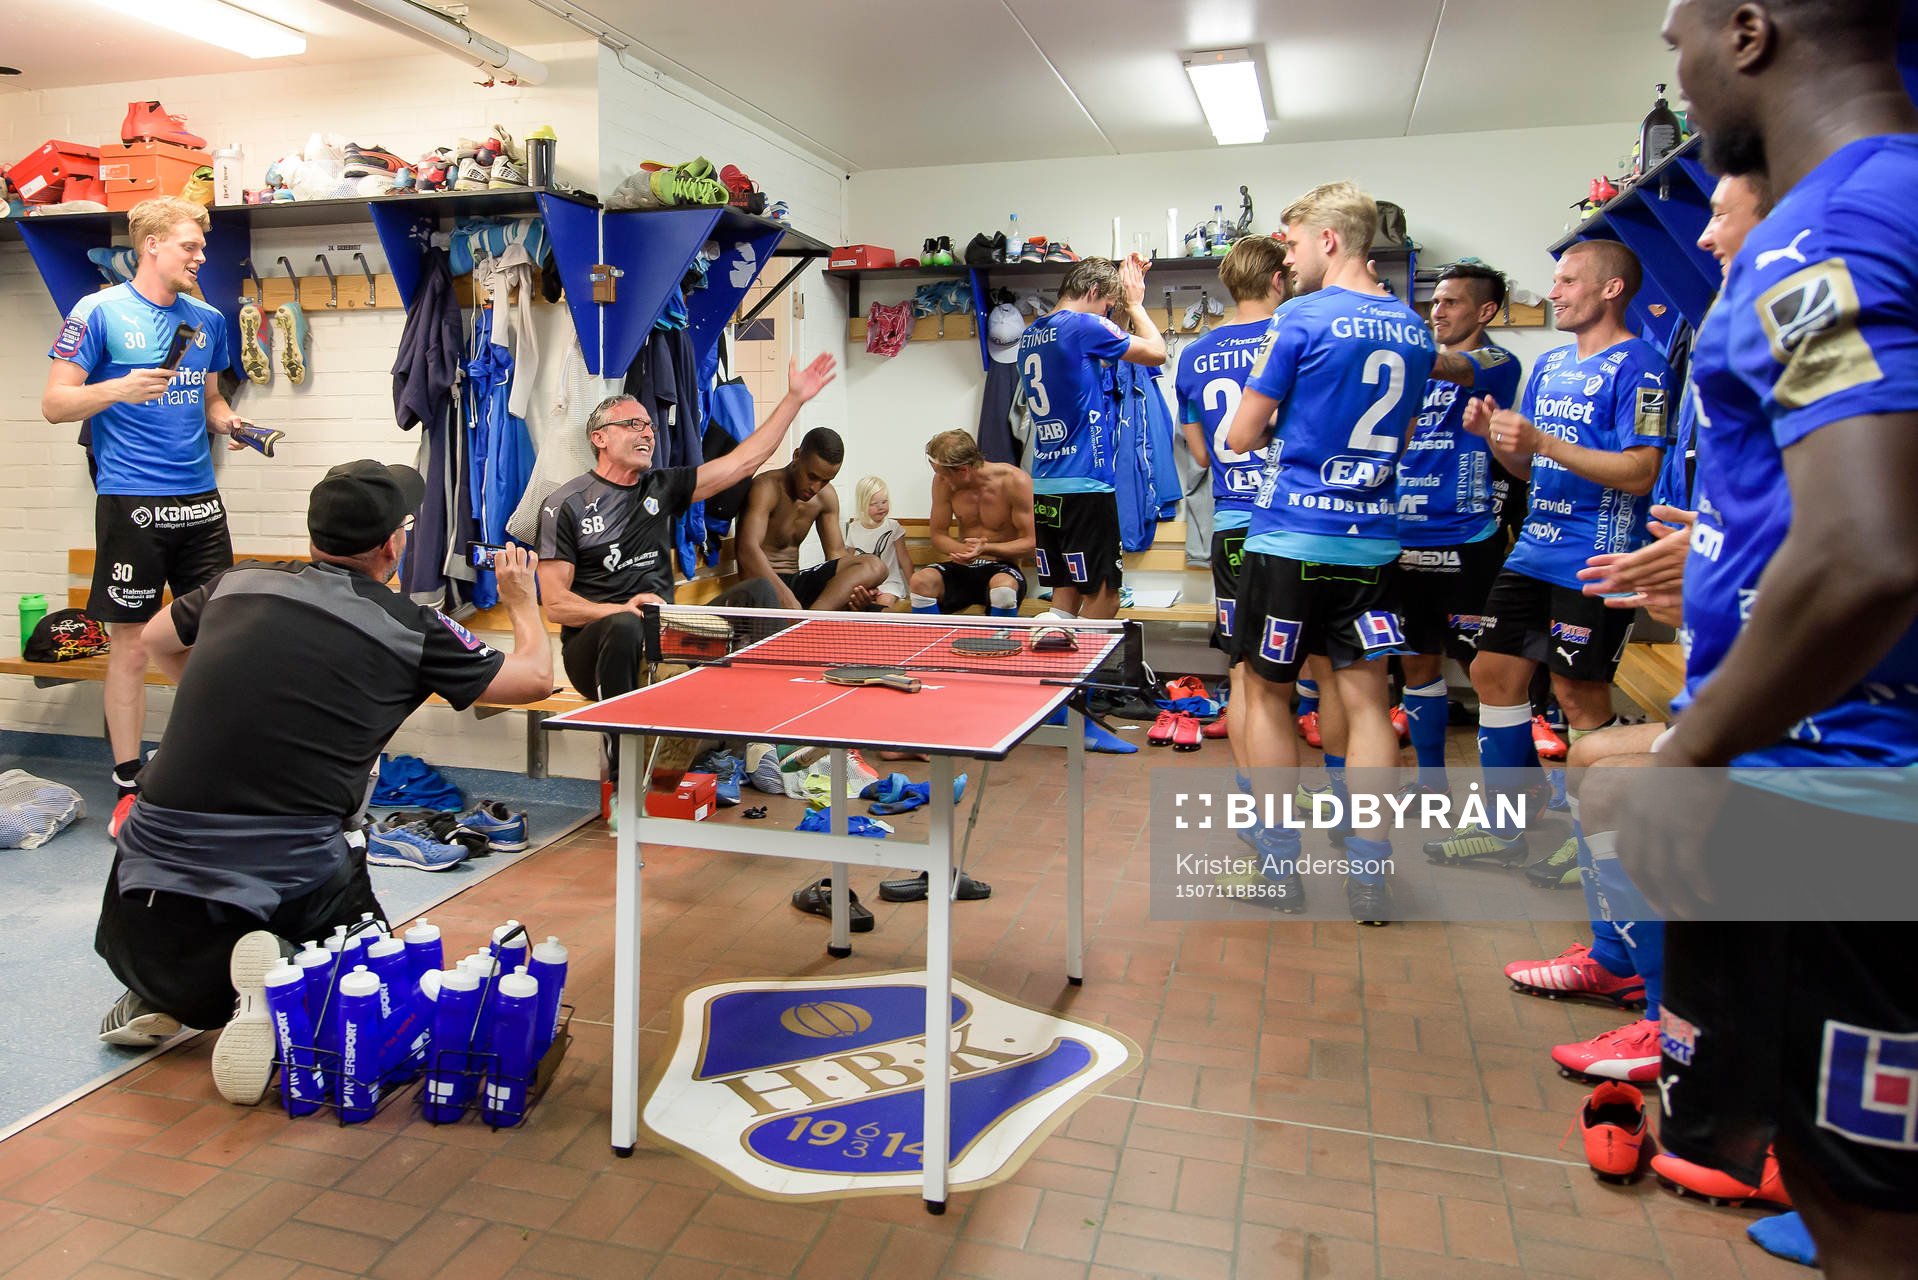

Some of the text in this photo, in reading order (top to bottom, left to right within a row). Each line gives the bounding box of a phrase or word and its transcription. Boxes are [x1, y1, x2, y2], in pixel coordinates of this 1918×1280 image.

[124, 331, 146, 349] 30
[1020, 327, 1057, 349] ETINGE
[1331, 316, 1428, 349] GETINGE
[1024, 353, 1050, 417] 3
[1348, 349, 1406, 453] 2
[581, 515, 606, 535] SB
[112, 562, 133, 583] 30
[785, 1116, 848, 1146] 19
